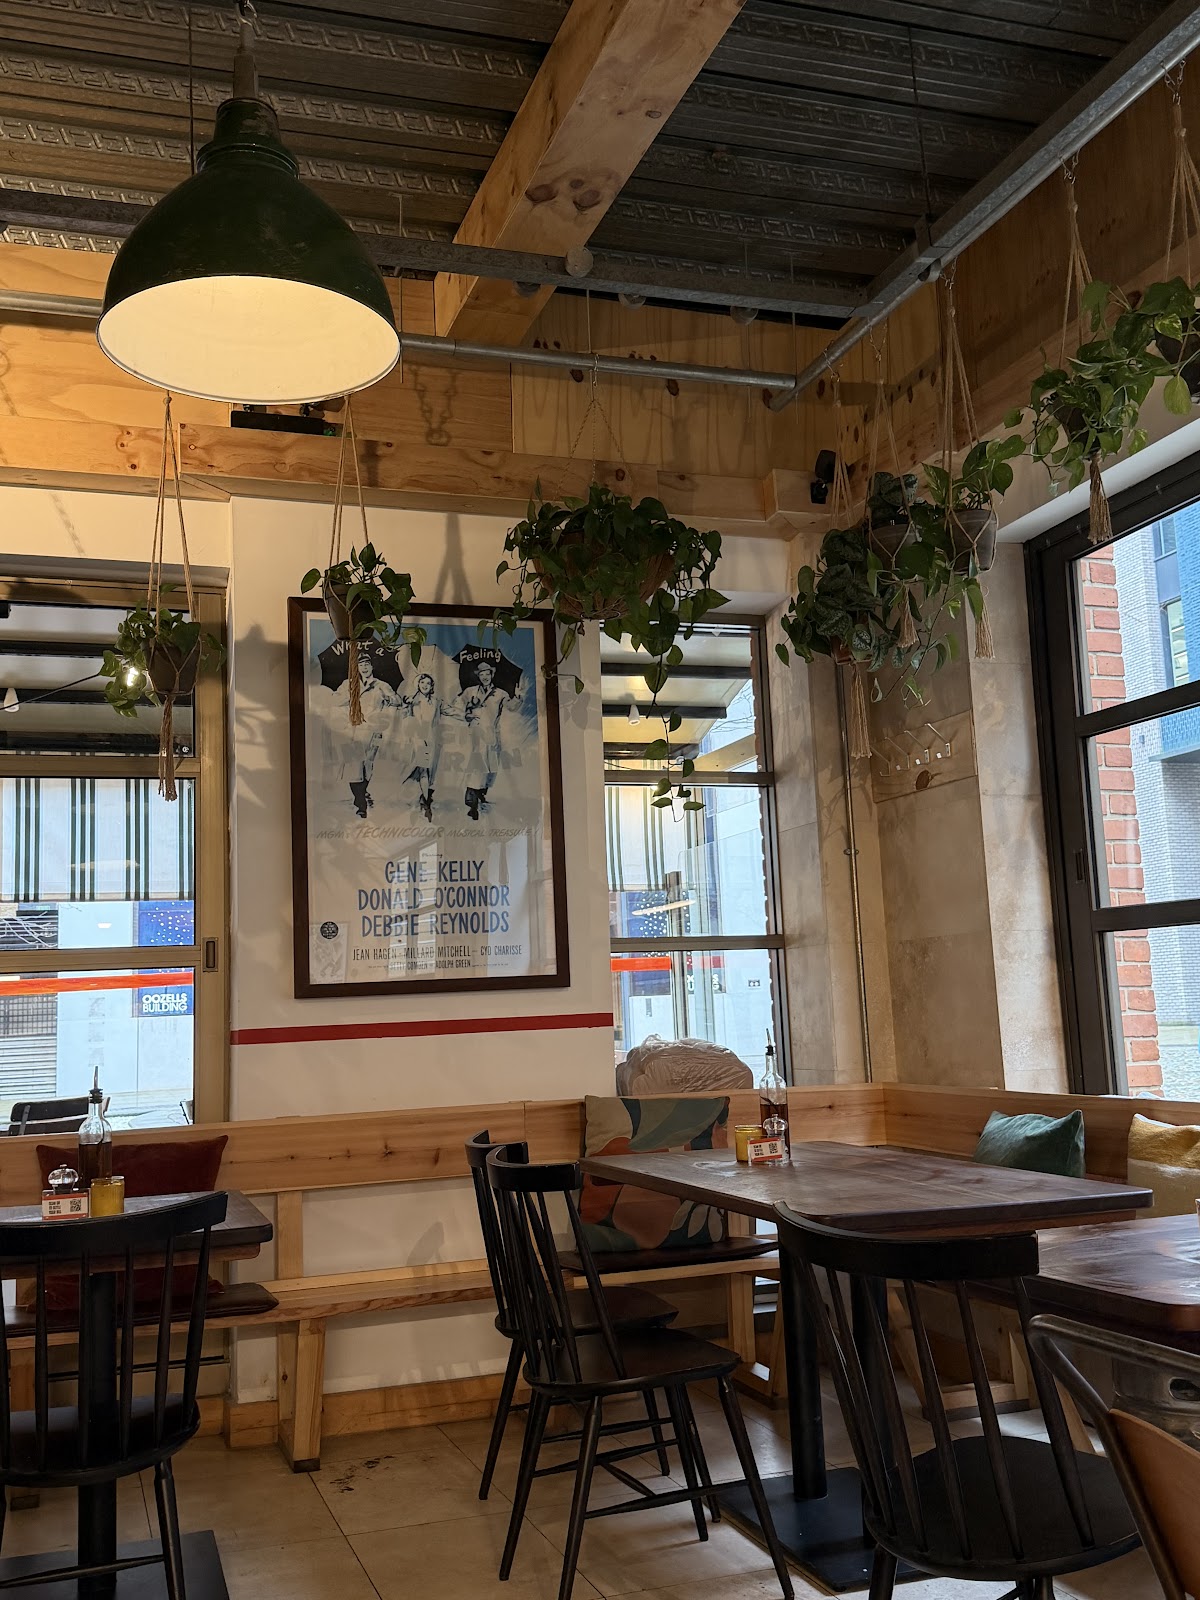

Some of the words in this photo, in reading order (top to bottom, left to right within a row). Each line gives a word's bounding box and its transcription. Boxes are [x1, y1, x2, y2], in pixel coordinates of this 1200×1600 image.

[375, 647, 385, 656] a
[459, 648, 501, 663] Feeling
[354, 825, 444, 839] TECHNICOLOR
[447, 828, 485, 837] MUSICAL
[385, 861, 427, 883] GENE
[438, 860, 484, 882] KELLY
[358, 887, 423, 910] DONALD
[434, 885, 510, 908] O'CONNOR
[362, 914, 419, 937] DEBBIE
[430, 911, 509, 935] REYNOLDS
[353, 948, 370, 960] JEAN
[373, 947, 397, 960] HAGEN
[437, 945, 471, 958] MITCHELL
[480, 945, 492, 956] CYD
[494, 944, 523, 956] CHARISSE
[455, 959, 471, 968] GREEN
[142, 993, 188, 1004] OOZELLS
[142, 1002, 188, 1013] BUILDING
